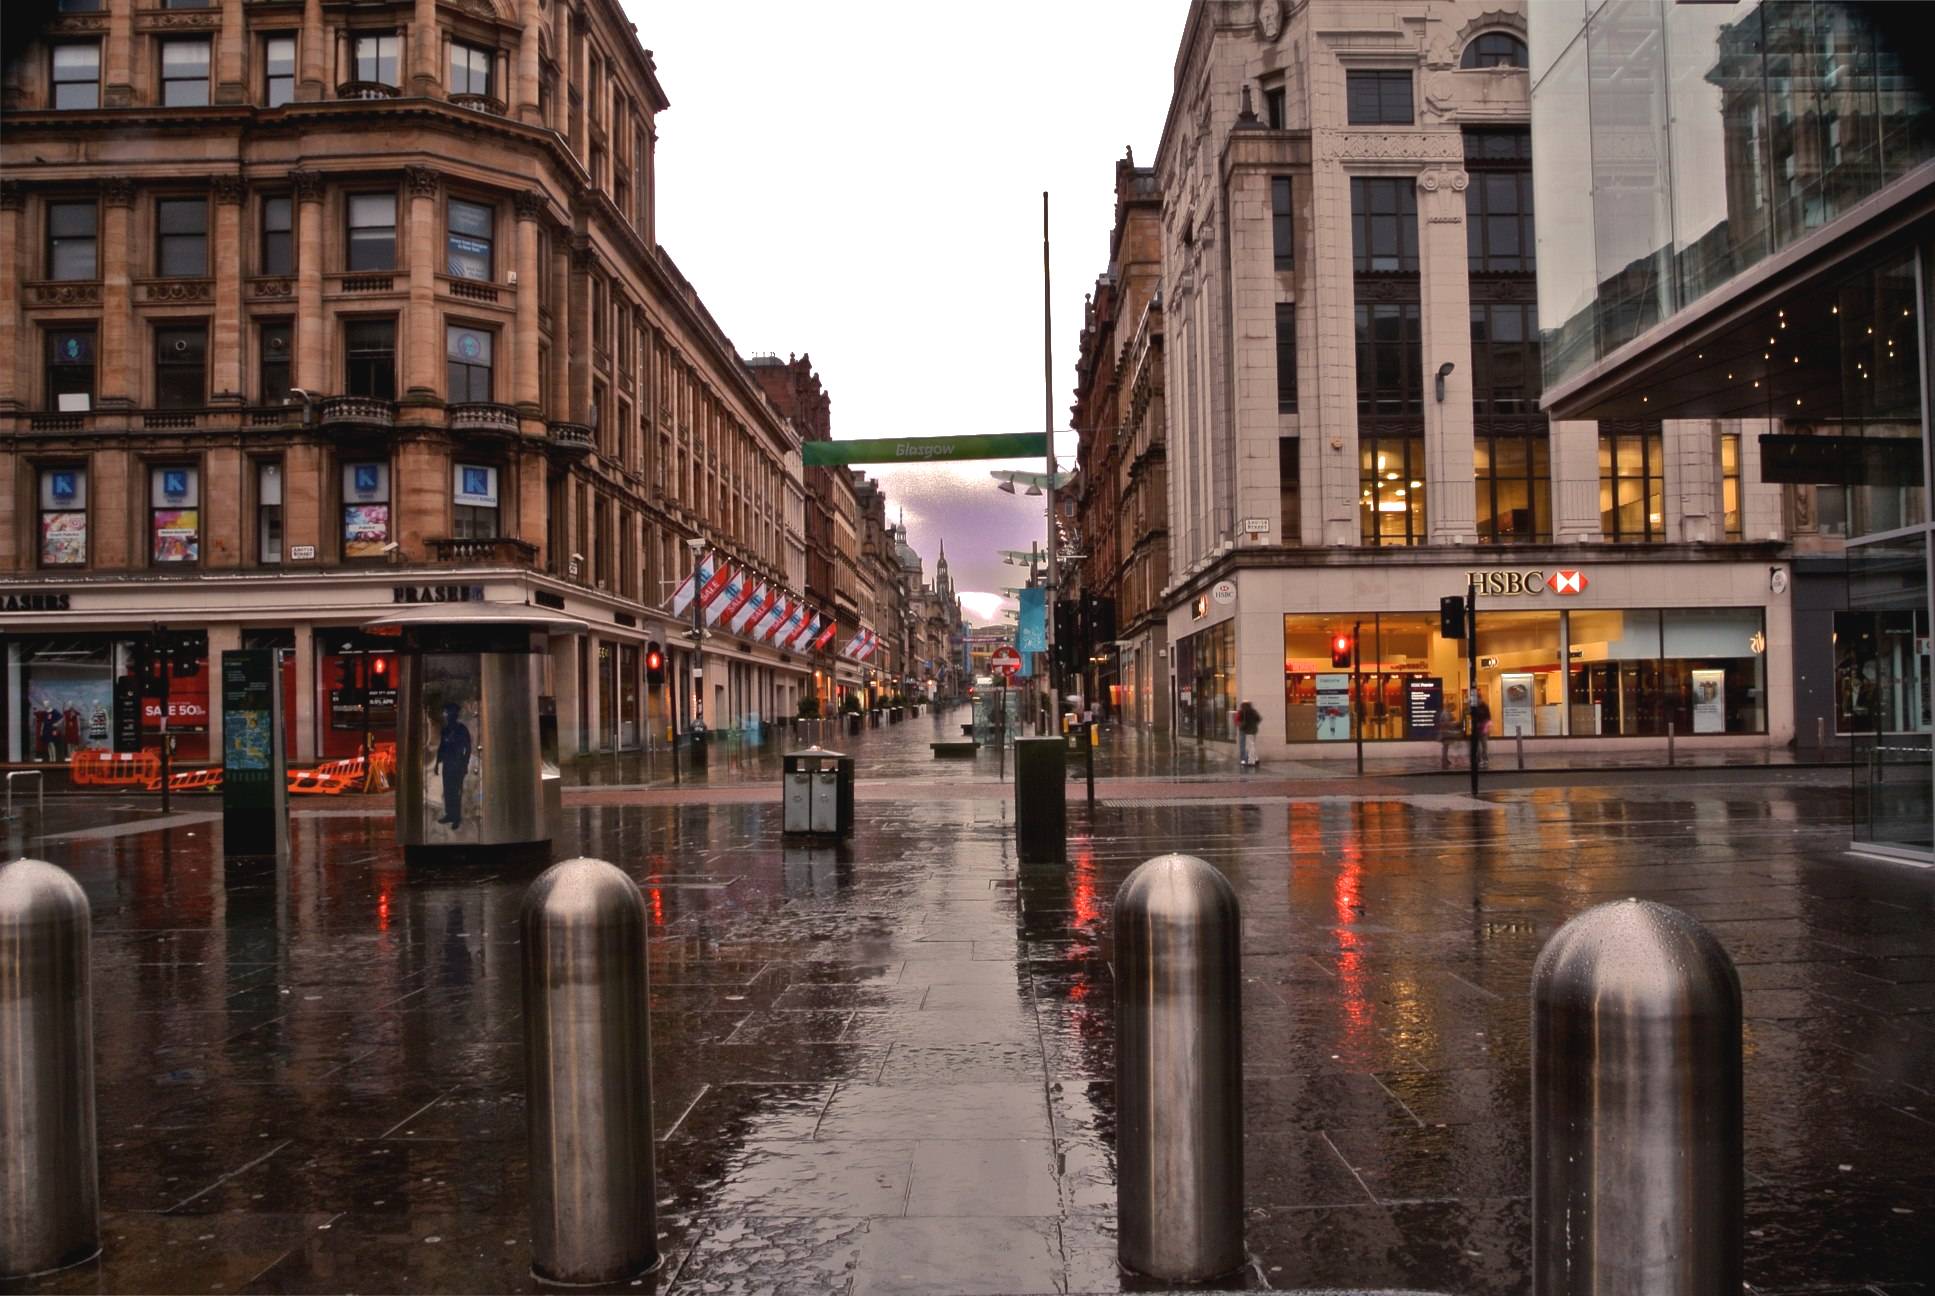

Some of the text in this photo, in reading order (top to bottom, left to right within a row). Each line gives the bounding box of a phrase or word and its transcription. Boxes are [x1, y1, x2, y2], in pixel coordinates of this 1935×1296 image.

[896, 442, 955, 459] Glasgow
[703, 581, 720, 599] SALE
[1465, 571, 1545, 596] HSBC
[0, 594, 70, 610] ASERS
[145, 706, 176, 716] SAE
